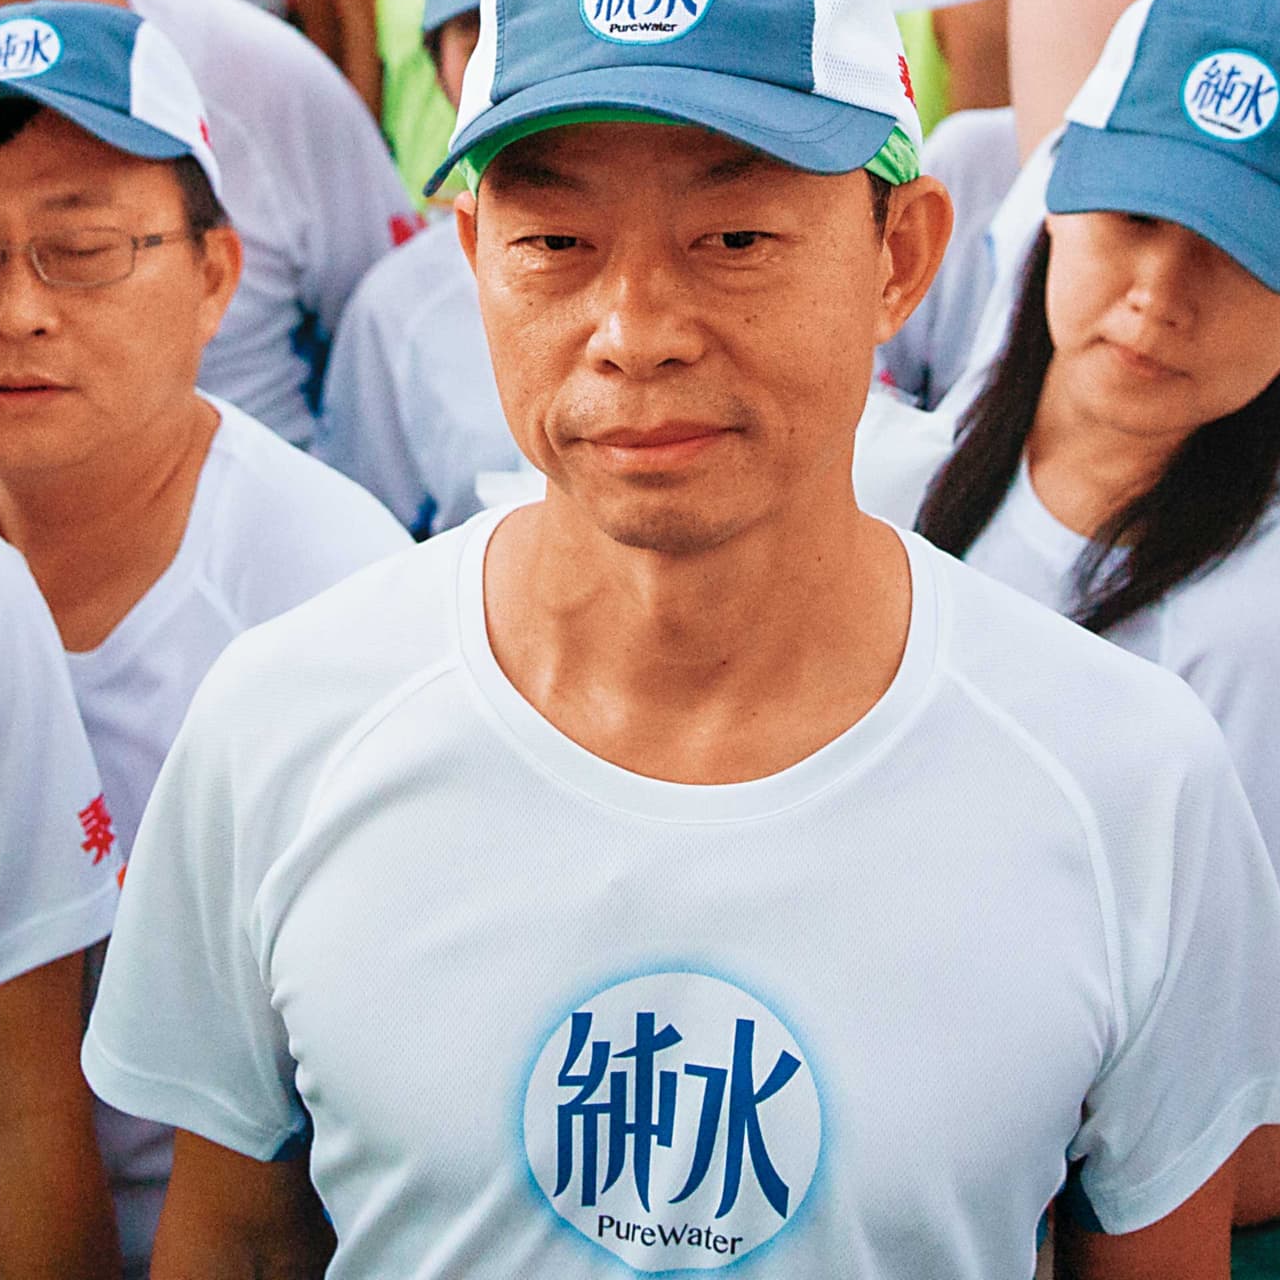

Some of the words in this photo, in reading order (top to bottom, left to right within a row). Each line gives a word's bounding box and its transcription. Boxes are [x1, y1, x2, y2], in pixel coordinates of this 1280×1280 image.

[1191, 60, 1276, 126] 純水
[553, 1012, 803, 1220] 純水
[597, 1214, 744, 1255] PureWater
